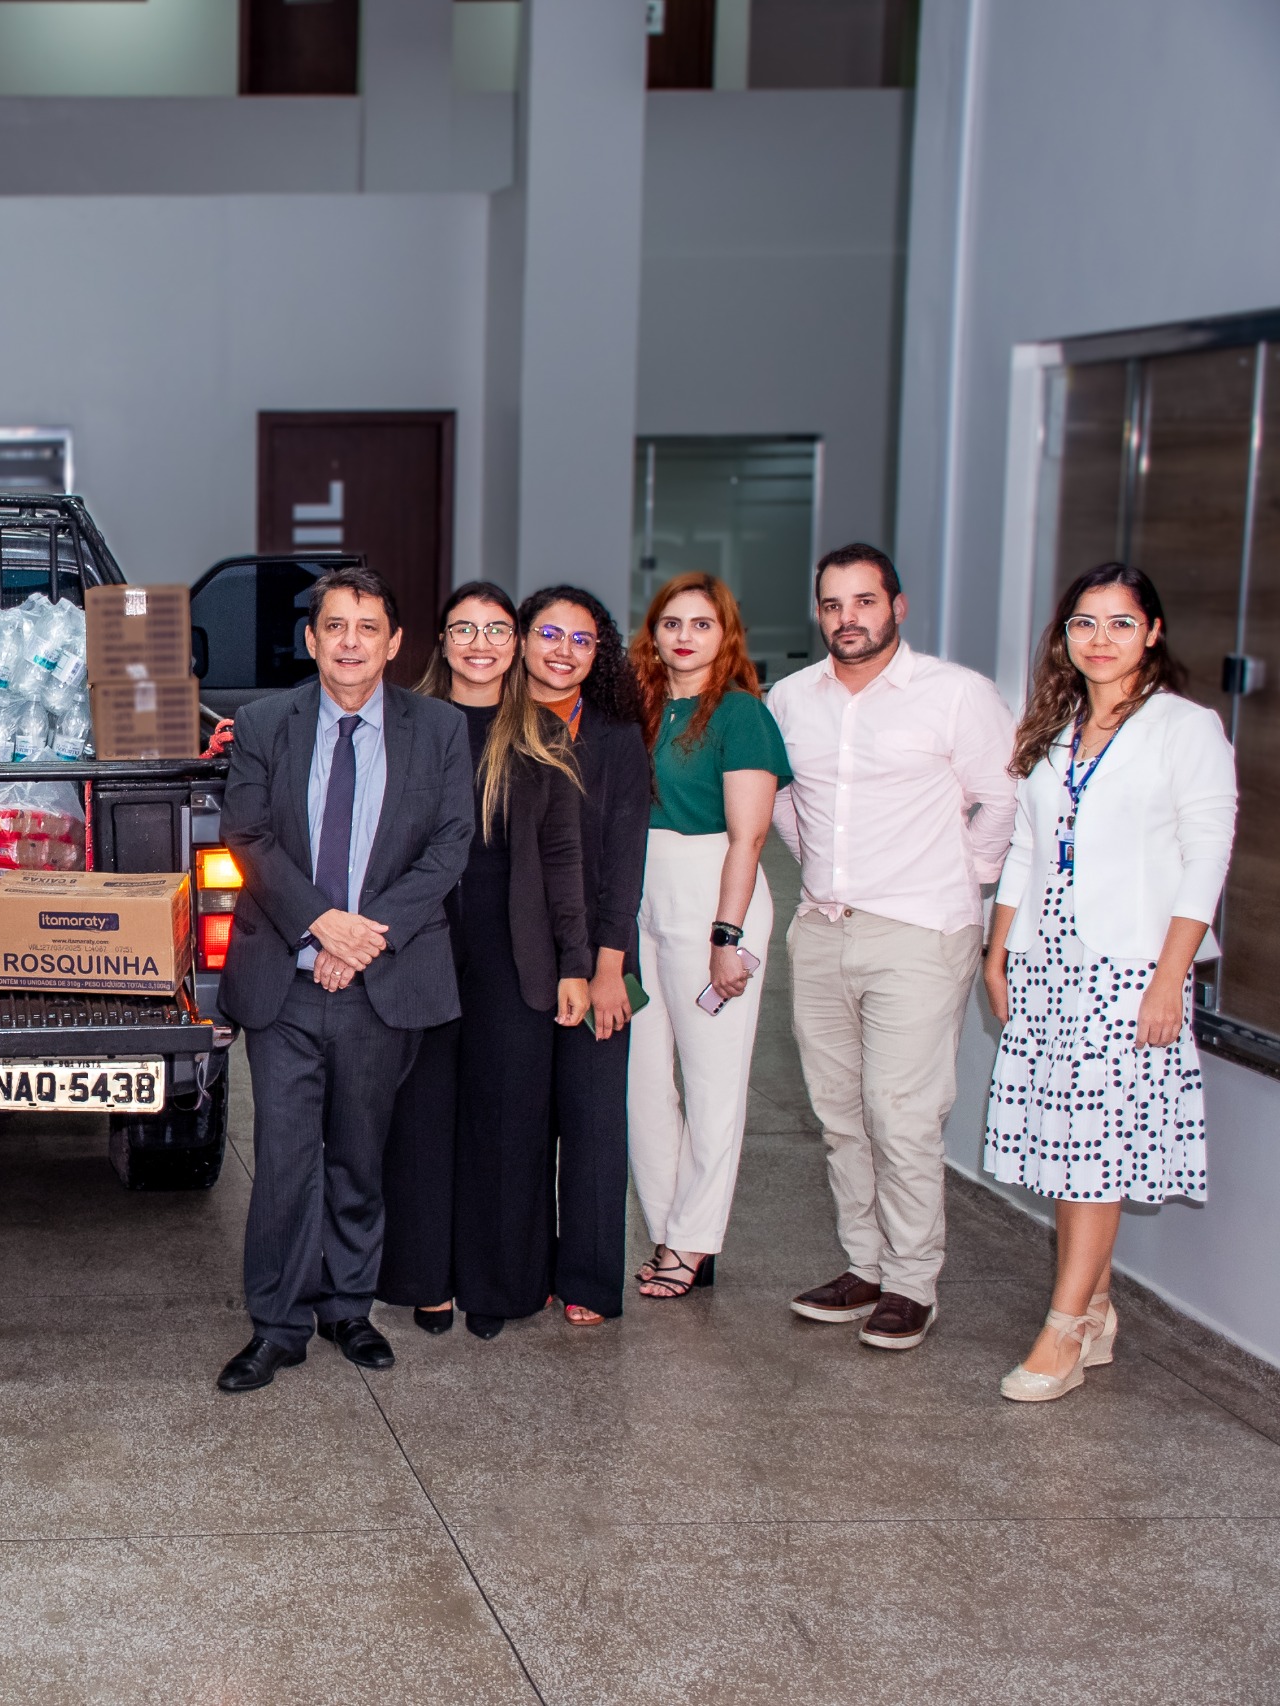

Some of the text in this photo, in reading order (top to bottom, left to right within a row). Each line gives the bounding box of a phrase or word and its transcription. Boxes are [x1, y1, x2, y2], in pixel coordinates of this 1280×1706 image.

[41, 912, 106, 929] itamaraty
[51, 938, 109, 946] www.itamaraty.com
[3, 953, 159, 976] ROSQUINHA
